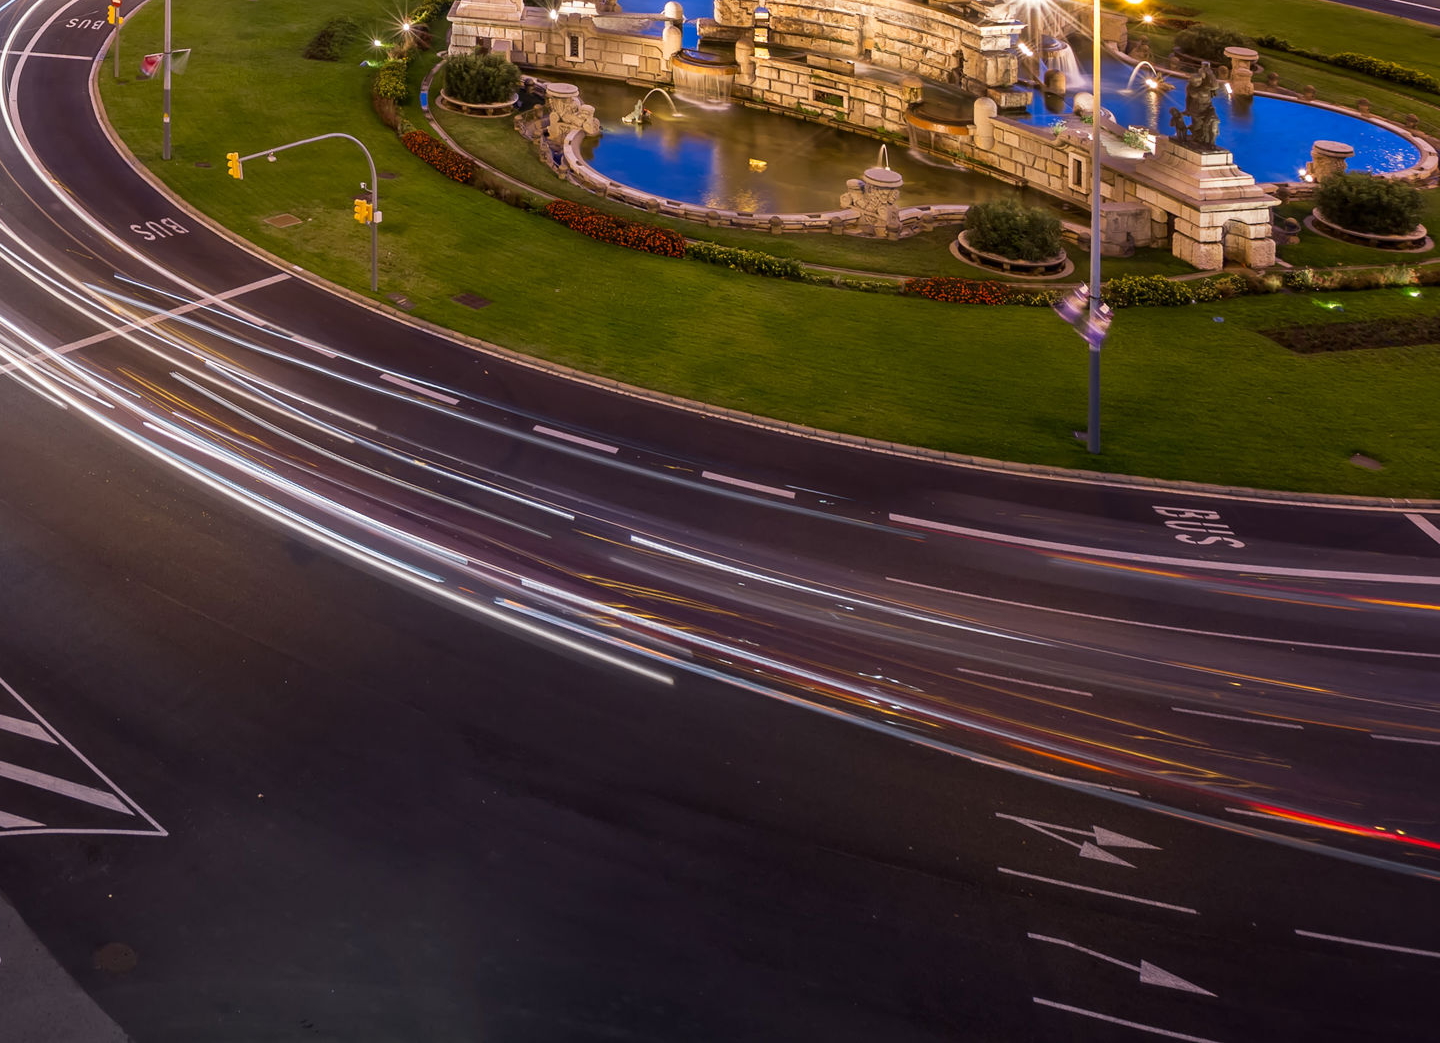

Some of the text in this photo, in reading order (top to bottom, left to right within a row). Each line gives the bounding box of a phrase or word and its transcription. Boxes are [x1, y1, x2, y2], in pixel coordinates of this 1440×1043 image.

[65, 18, 106, 30] BUS
[129, 217, 190, 241] BUS
[1151, 505, 1246, 549] BUS
